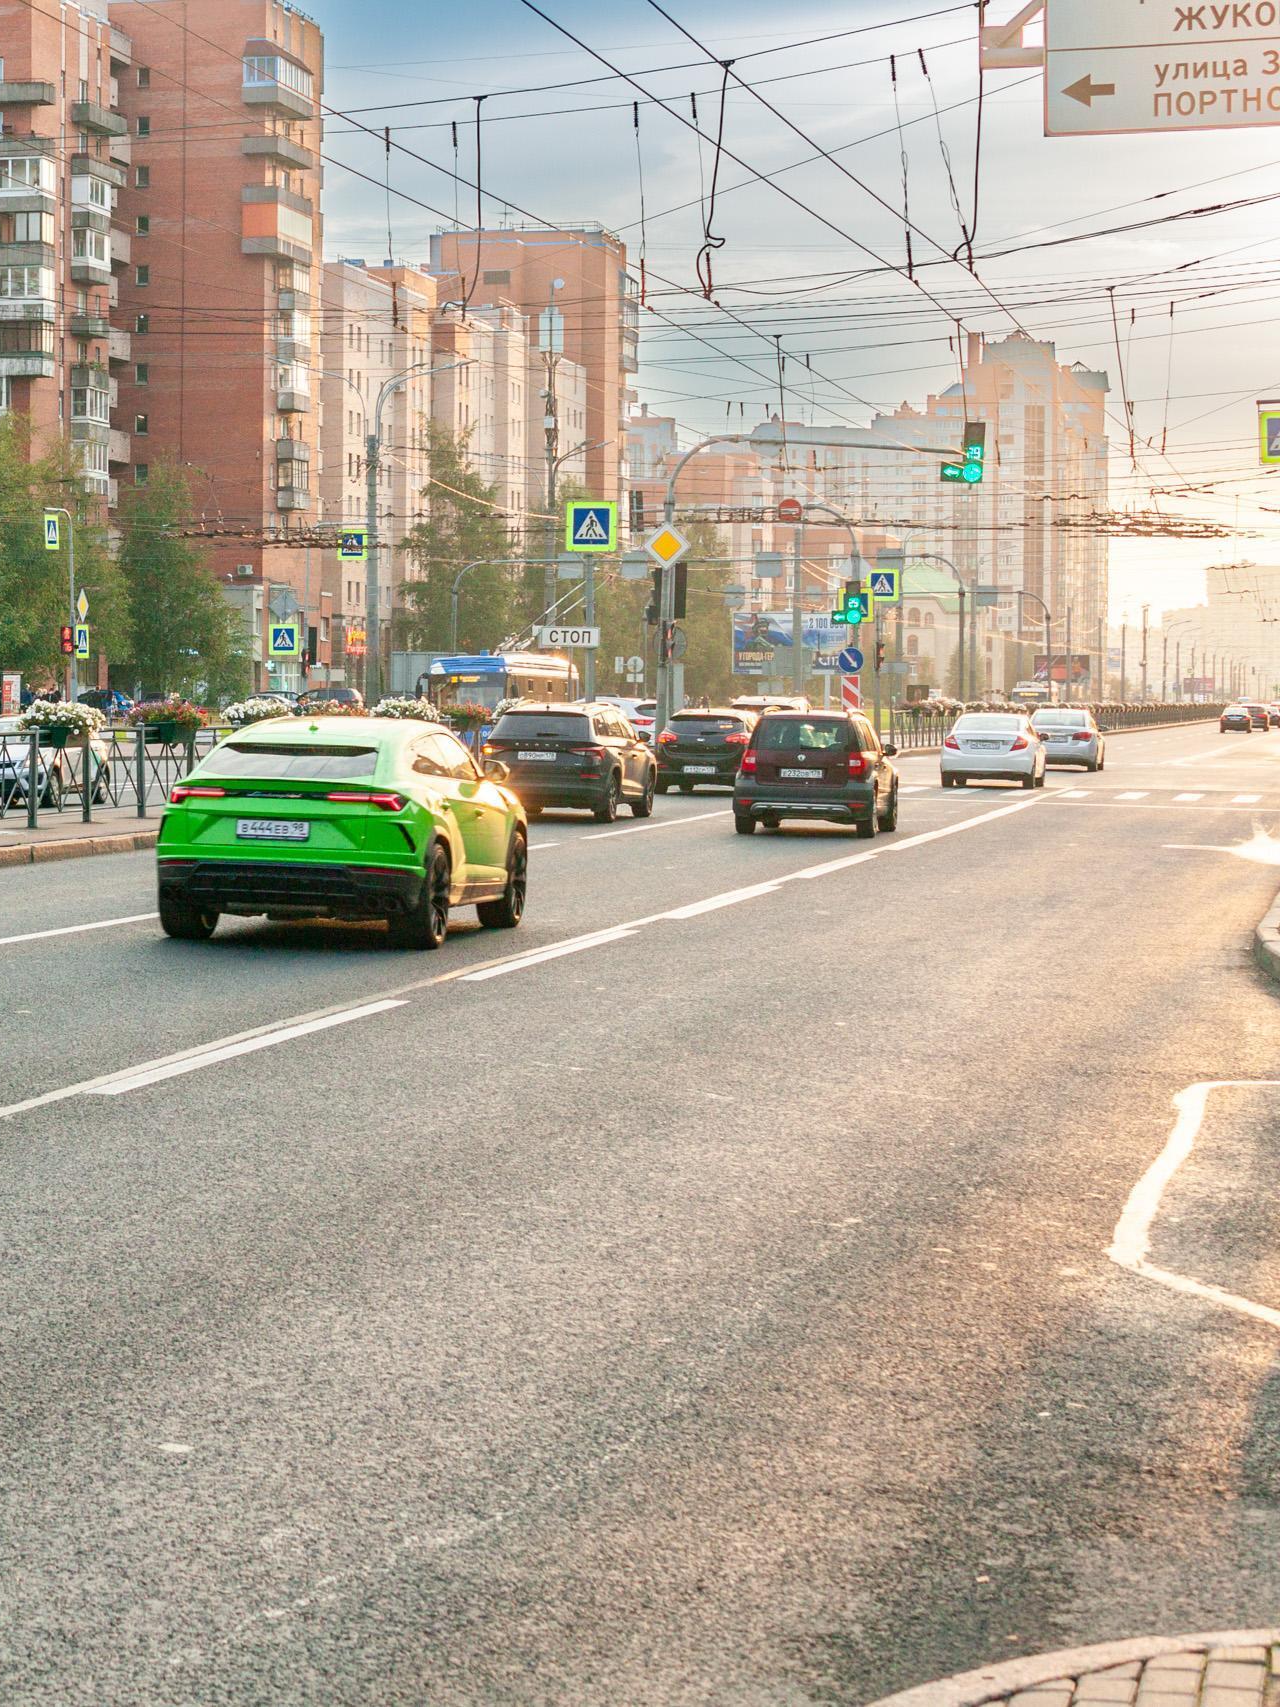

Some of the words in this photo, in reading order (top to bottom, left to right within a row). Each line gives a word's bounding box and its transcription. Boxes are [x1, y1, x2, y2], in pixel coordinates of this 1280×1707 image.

[1173, 1, 1280, 31] ЖУКО
[1154, 58, 1248, 88] улица
[1153, 86, 1280, 117] ПОРТНО
[549, 630, 591, 643] СТОП
